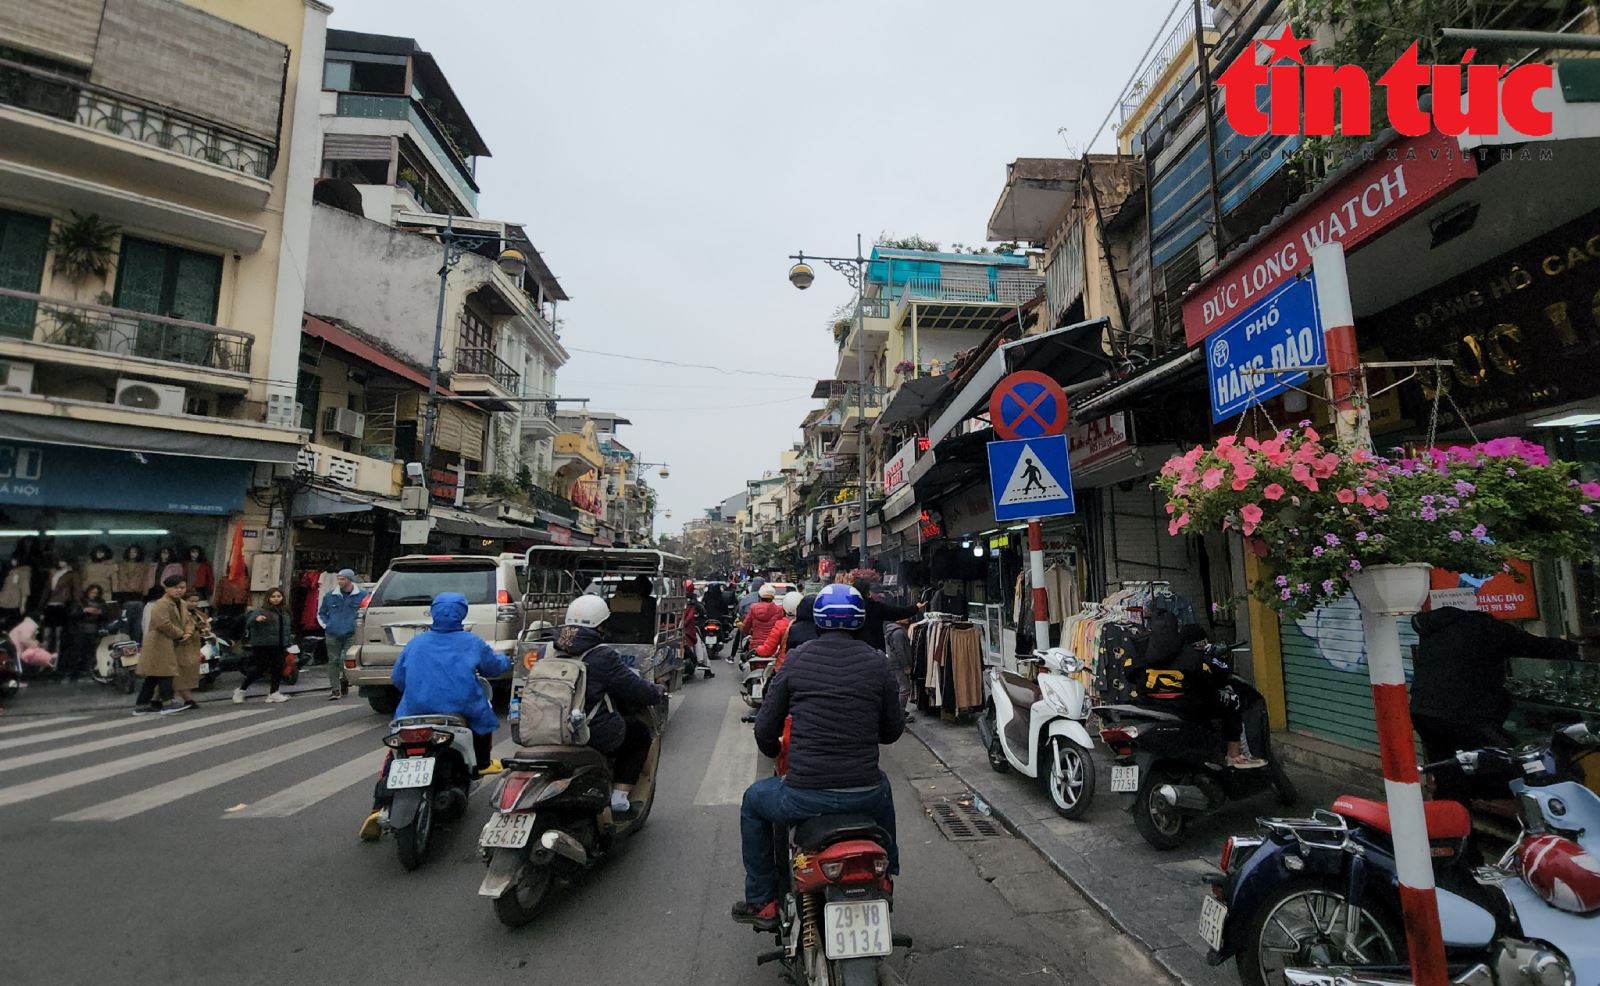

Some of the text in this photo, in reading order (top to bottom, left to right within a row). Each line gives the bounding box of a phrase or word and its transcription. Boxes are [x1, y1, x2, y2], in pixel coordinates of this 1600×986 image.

[1202, 164, 1408, 325] ĐỨC LONG WATCH
[1245, 298, 1280, 342] PHỐ
[1217, 326, 1315, 407] HÀNG ĐÀO
[397, 760, 428, 774] 29-B1
[391, 773, 430, 787] 941.48
[486, 829, 527, 845] 254.62
[836, 929, 883, 954] 9134
